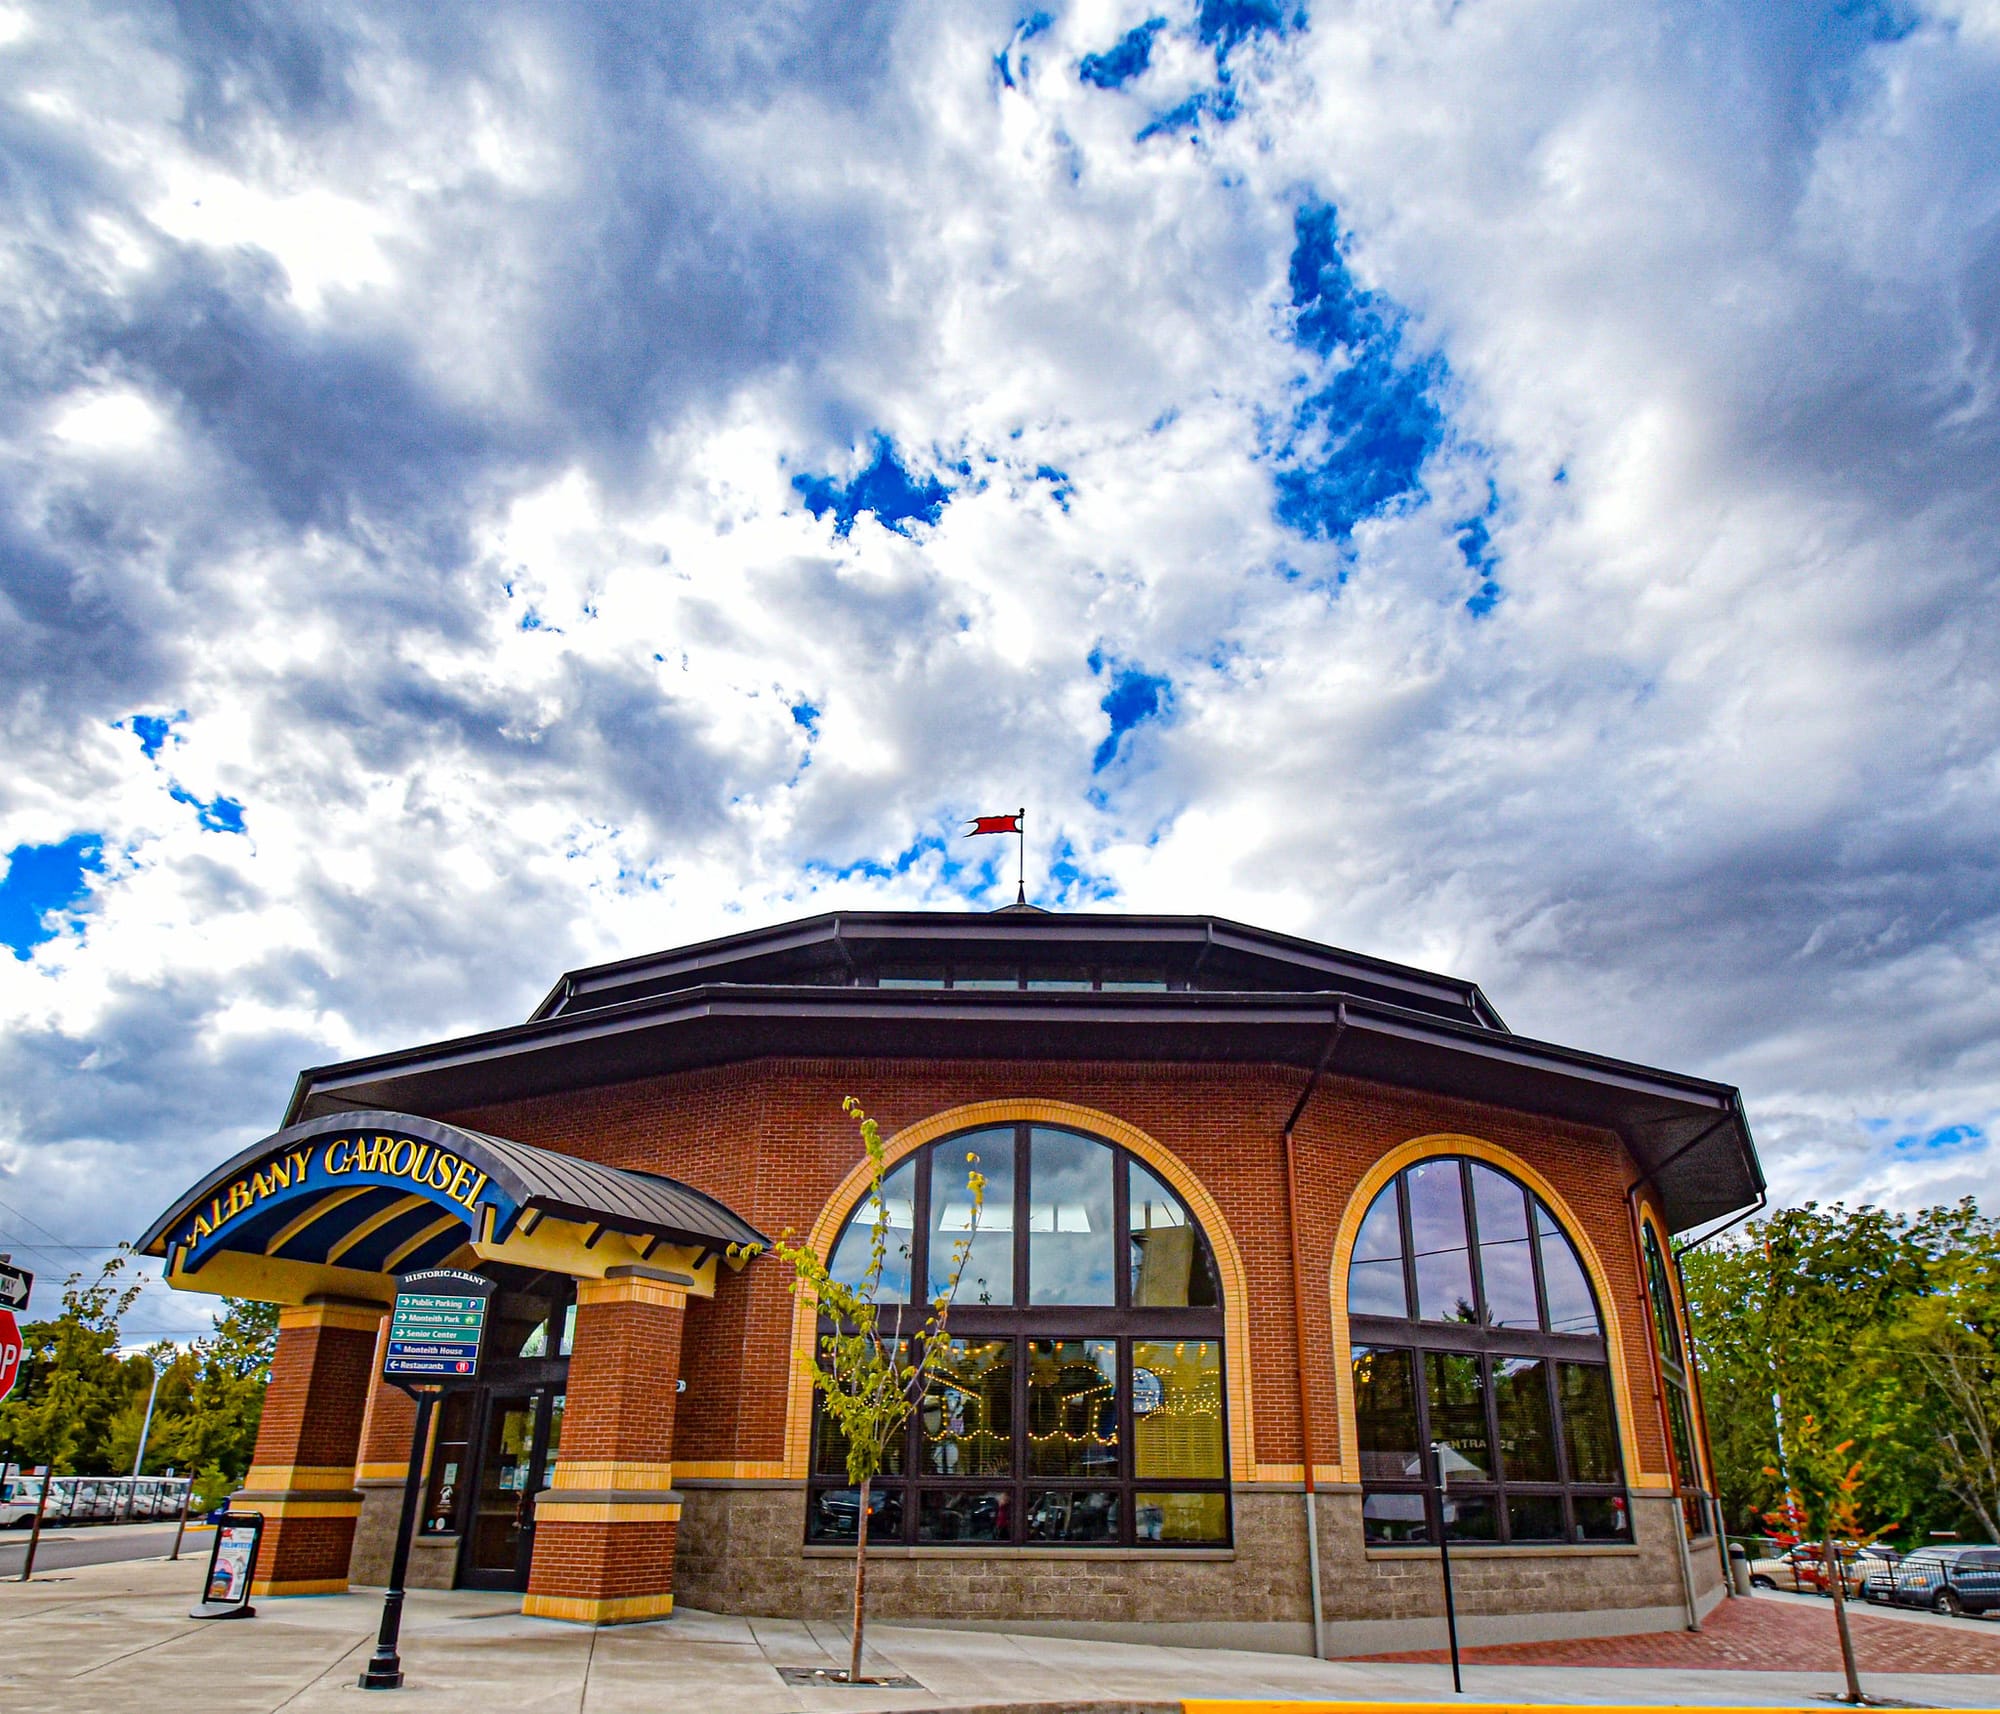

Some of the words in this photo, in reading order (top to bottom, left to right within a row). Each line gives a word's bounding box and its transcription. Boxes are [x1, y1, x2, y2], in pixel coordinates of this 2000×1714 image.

[184, 1145, 315, 1250] ALBANY
[323, 1135, 489, 1214] CAROUSEL
[404, 1270, 451, 1283] HISTORIC
[451, 1270, 487, 1286] ALBANY
[411, 1298, 434, 1306] Public
[435, 1299, 463, 1309] Parking
[408, 1313, 442, 1323] Monteith
[443, 1315, 460, 1323] Park
[406, 1329, 431, 1338] Senior
[431, 1330, 458, 1339] Center
[403, 1345, 439, 1354] Monteith
[439, 1346, 464, 1355] House
[400, 1361, 445, 1370] Restaurants
